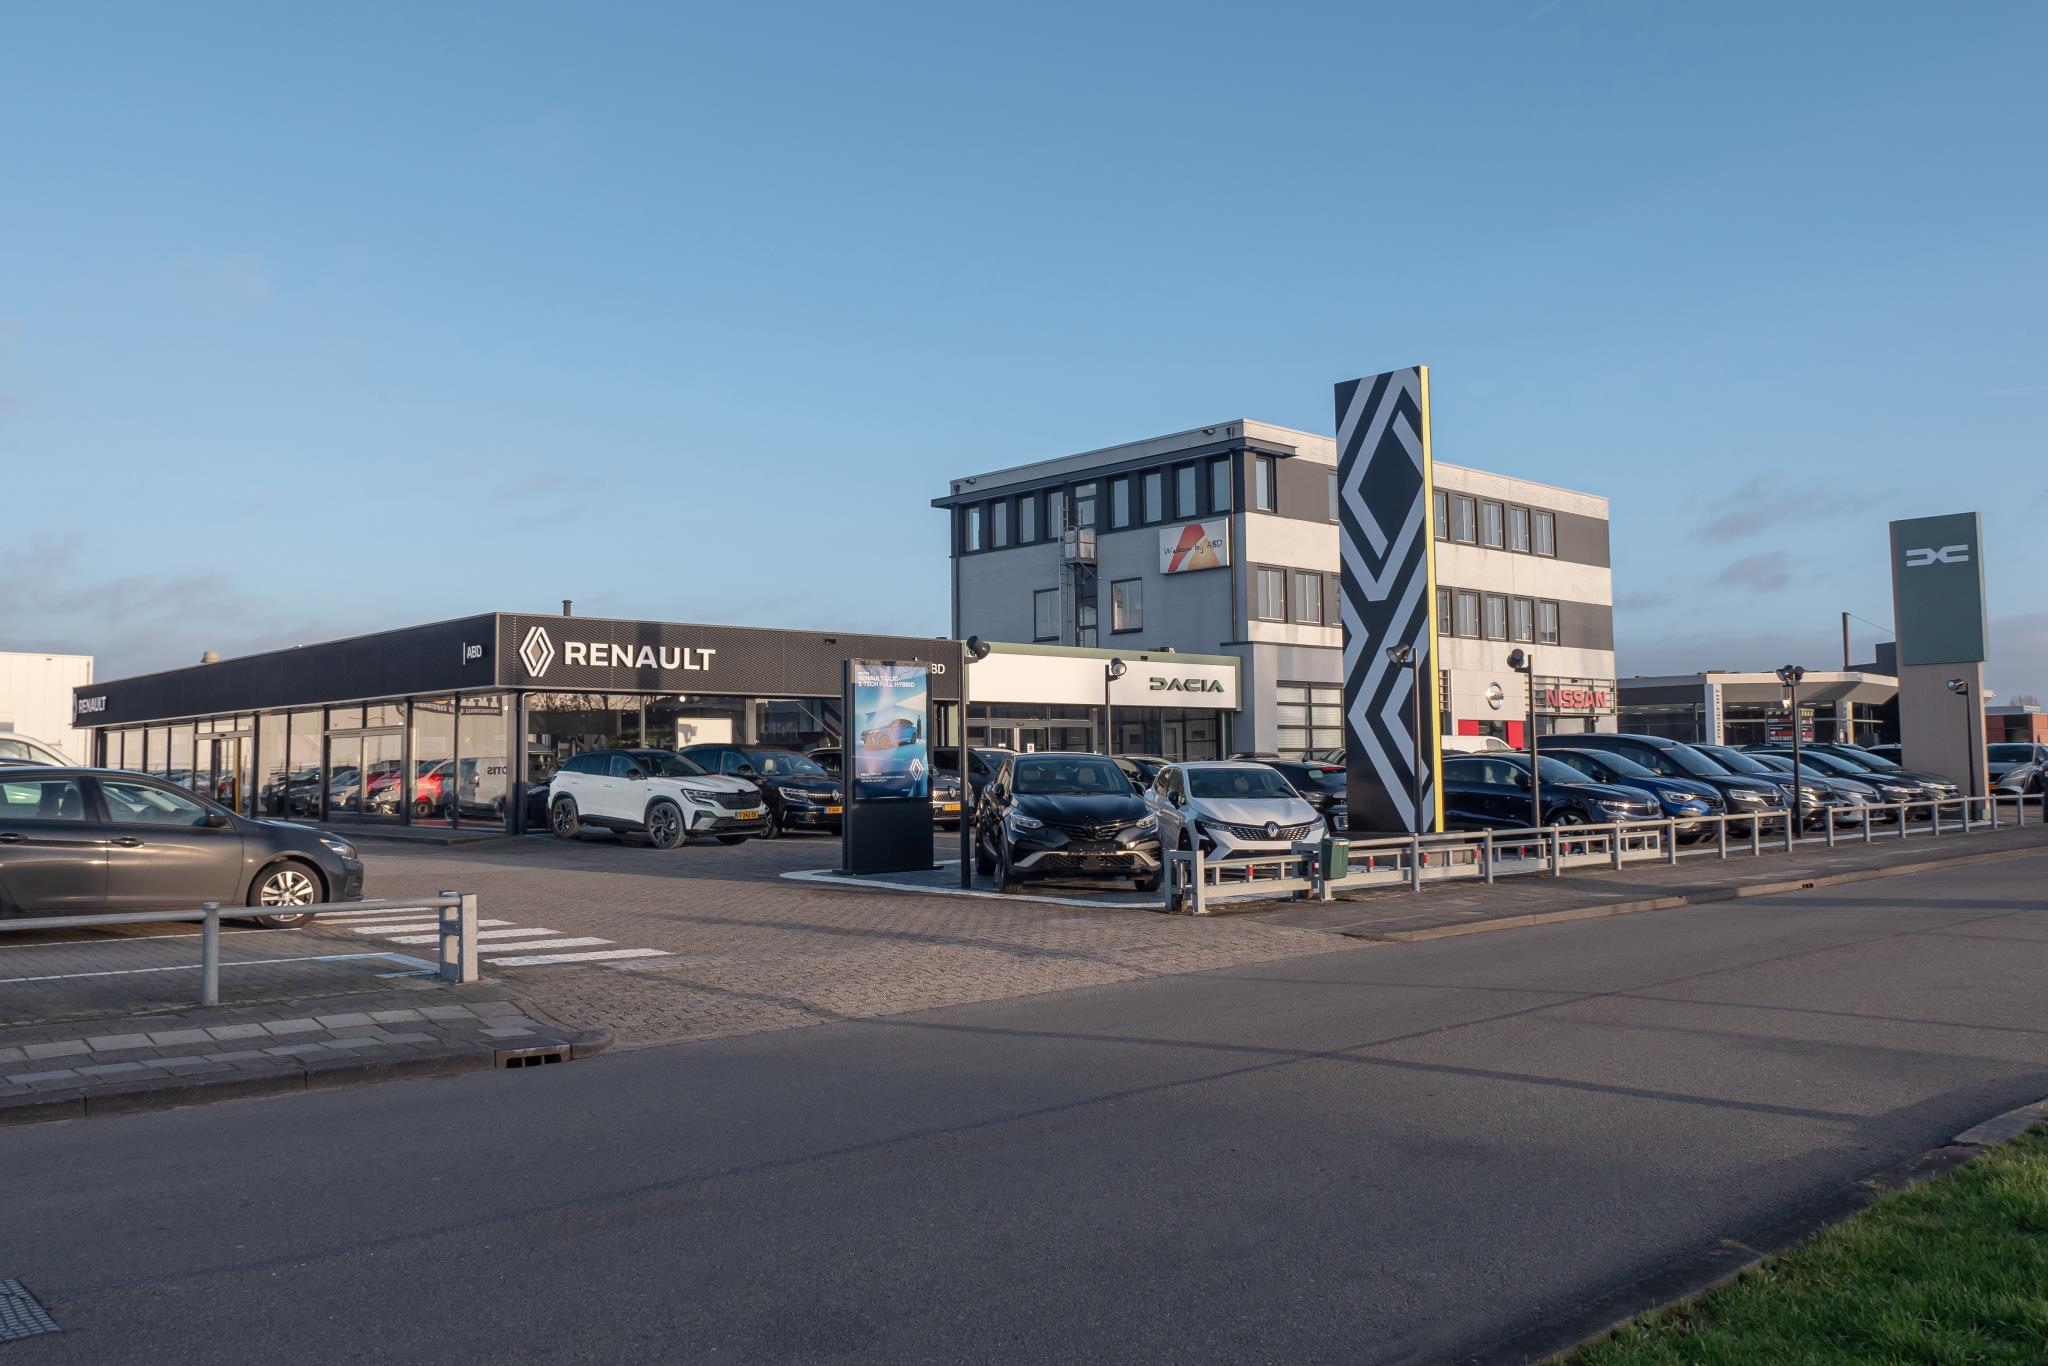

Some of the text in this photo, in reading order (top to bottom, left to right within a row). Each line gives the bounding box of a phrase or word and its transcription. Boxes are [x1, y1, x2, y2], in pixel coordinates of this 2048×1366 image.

[1207, 539, 1223, 549] ABD
[466, 644, 483, 659] ABD
[564, 641, 716, 671] RENAULT
[1149, 677, 1225, 692] DACIA
[78, 696, 107, 714] RENAULT
[1545, 688, 1607, 709] NISSAN
